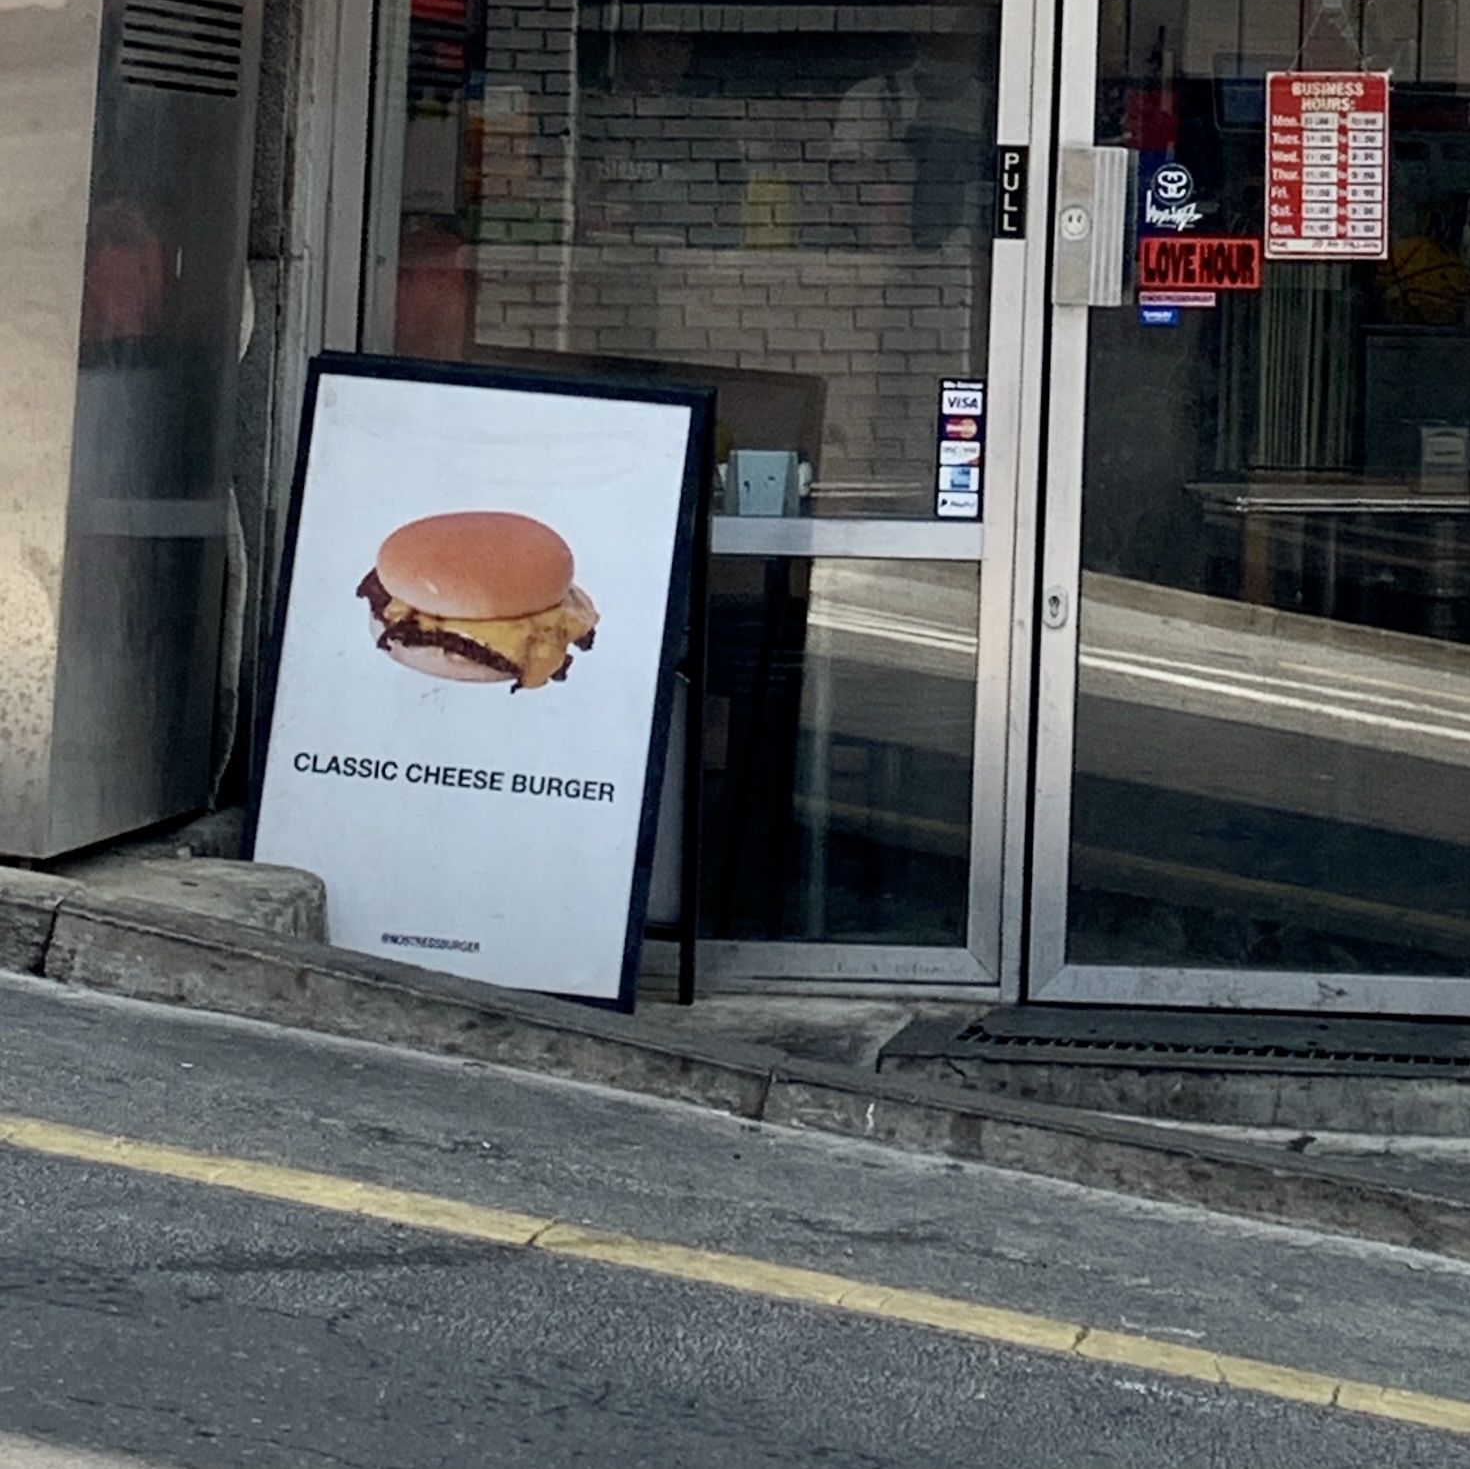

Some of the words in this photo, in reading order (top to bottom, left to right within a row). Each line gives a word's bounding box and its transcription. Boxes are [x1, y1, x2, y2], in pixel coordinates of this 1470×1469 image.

[1291, 81, 1364, 97] BUSINESS
[1301, 97, 1356, 111] HOURS:
[1003, 152, 1020, 232] PULL
[1144, 242, 1196, 283] LOVE
[1199, 242, 1255, 284] HOUR
[948, 396, 978, 409] VISA
[294, 752, 398, 780] CLASSIC
[405, 763, 505, 792] CHEESE
[511, 773, 615, 802] BURGER
